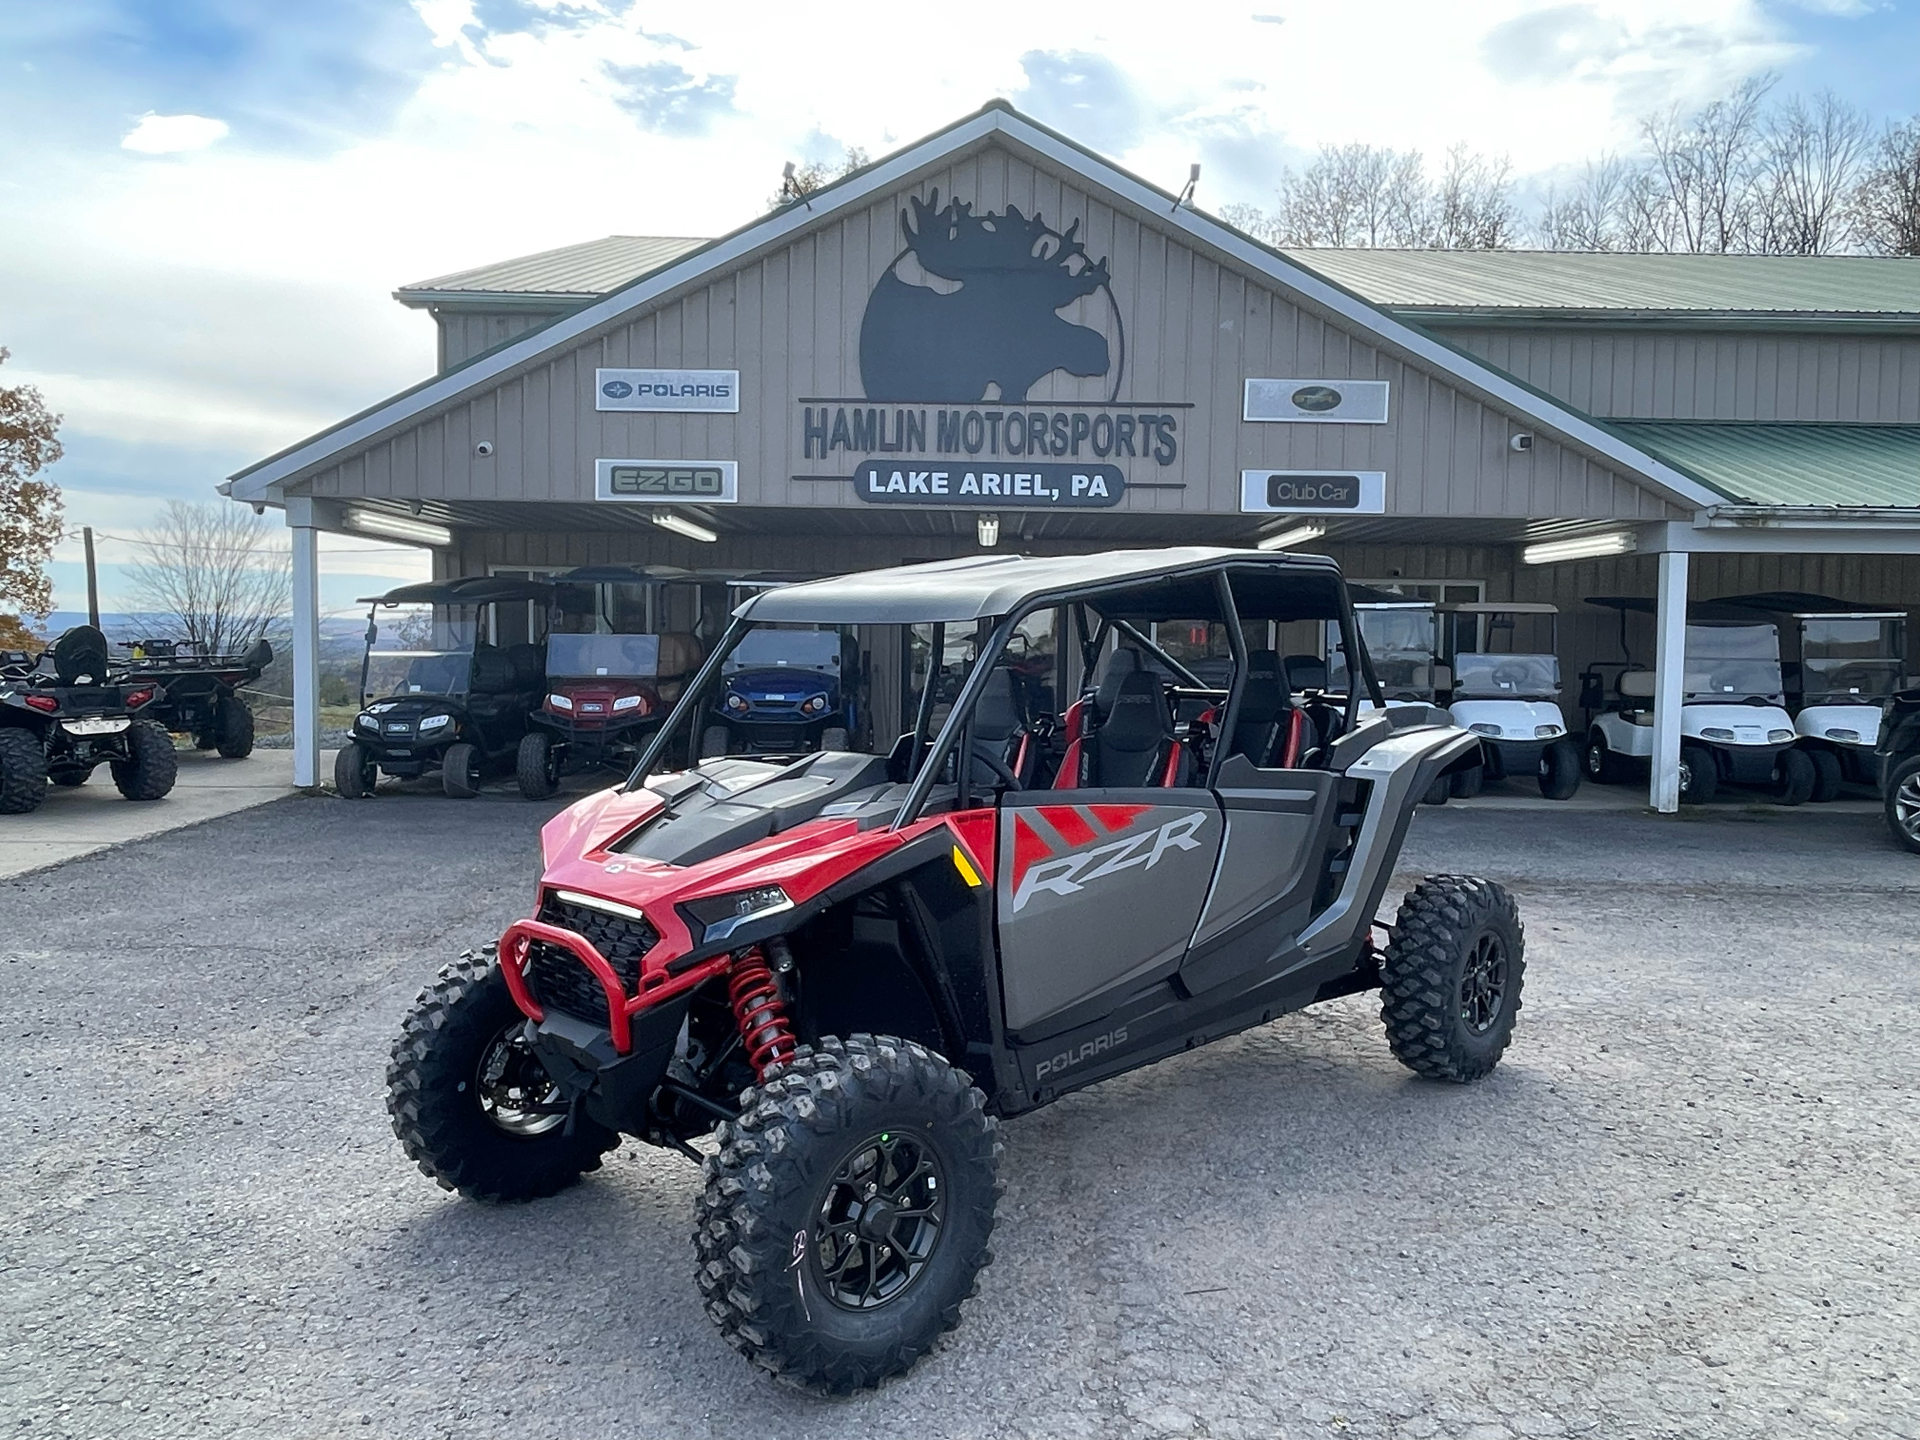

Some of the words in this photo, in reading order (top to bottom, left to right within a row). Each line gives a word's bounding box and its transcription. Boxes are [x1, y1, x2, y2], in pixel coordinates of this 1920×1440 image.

[638, 384, 730, 398] POLARIS
[804, 407, 926, 460] HAMLIN
[937, 410, 1177, 466] MOTORSPORTS
[614, 469, 719, 492] EZGO
[869, 471, 949, 494] LAKE
[959, 472, 1060, 501] ARIEL,
[1071, 474, 1109, 498] PA
[1277, 482, 1317, 501] Club
[1319, 483, 1350, 501] Car
[1013, 811, 1208, 914] RZR
[1035, 1026, 1129, 1081] POLARIS
